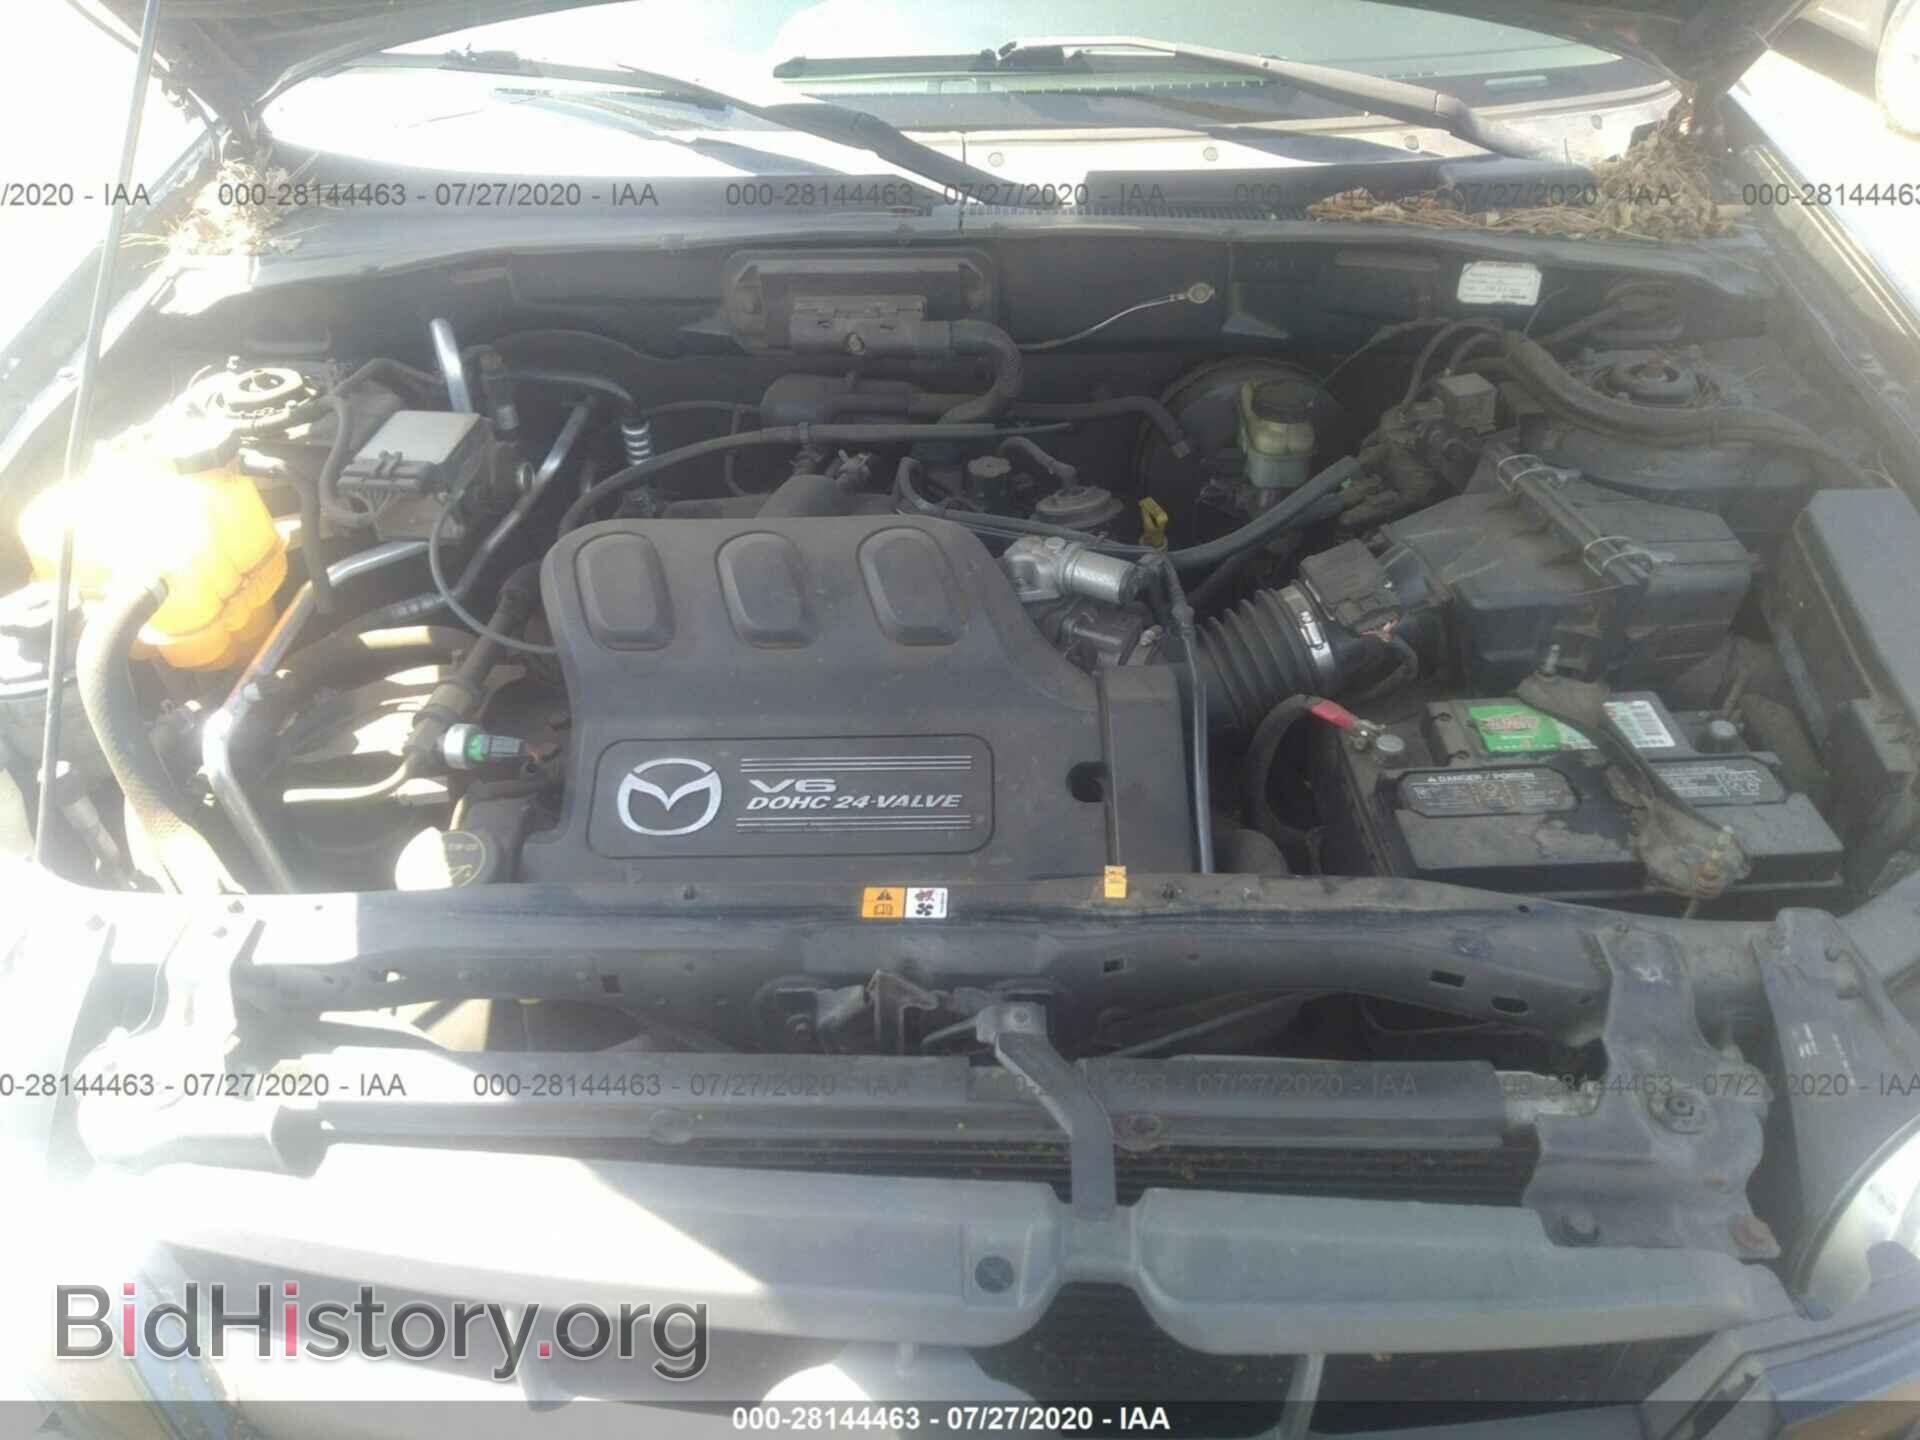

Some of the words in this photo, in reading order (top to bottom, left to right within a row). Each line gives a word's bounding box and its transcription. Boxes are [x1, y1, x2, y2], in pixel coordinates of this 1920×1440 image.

[749, 779, 837, 793] V6
[746, 796, 831, 810] DOHC
[832, 794, 963, 809] 24-VALVE
